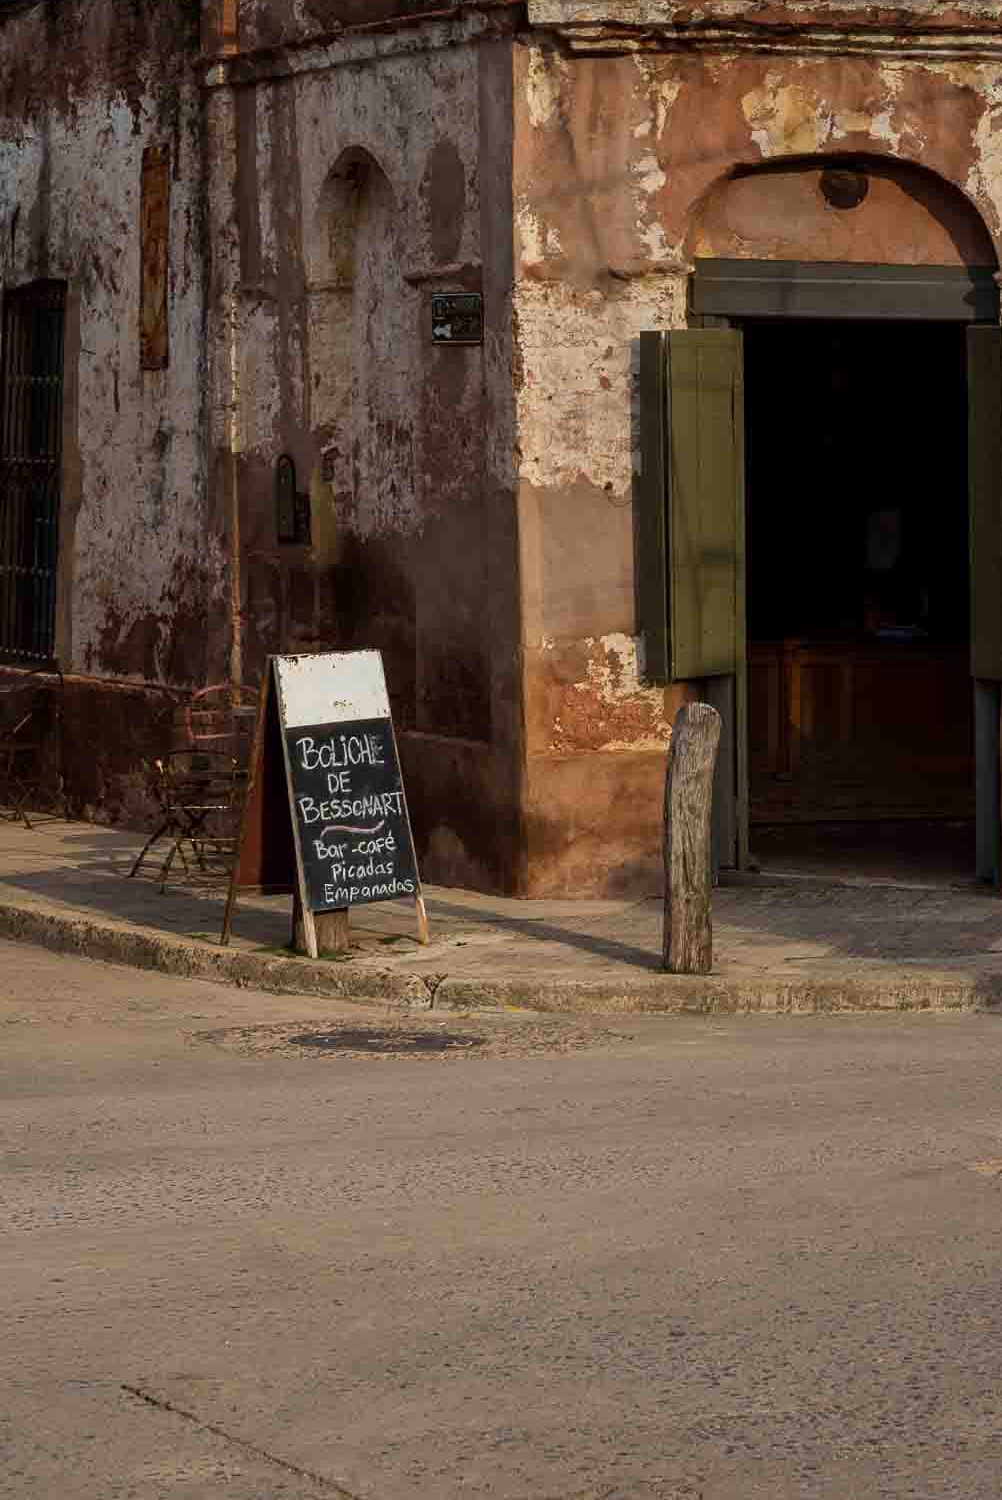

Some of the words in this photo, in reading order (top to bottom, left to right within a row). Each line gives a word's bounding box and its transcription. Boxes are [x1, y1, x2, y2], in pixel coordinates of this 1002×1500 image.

[327, 771, 353, 794] DE
[299, 791, 402, 823] BESSONART
[313, 839, 348, 860] Bar
[331, 856, 394, 882] Picadas
[324, 877, 415, 903] Empanadas
